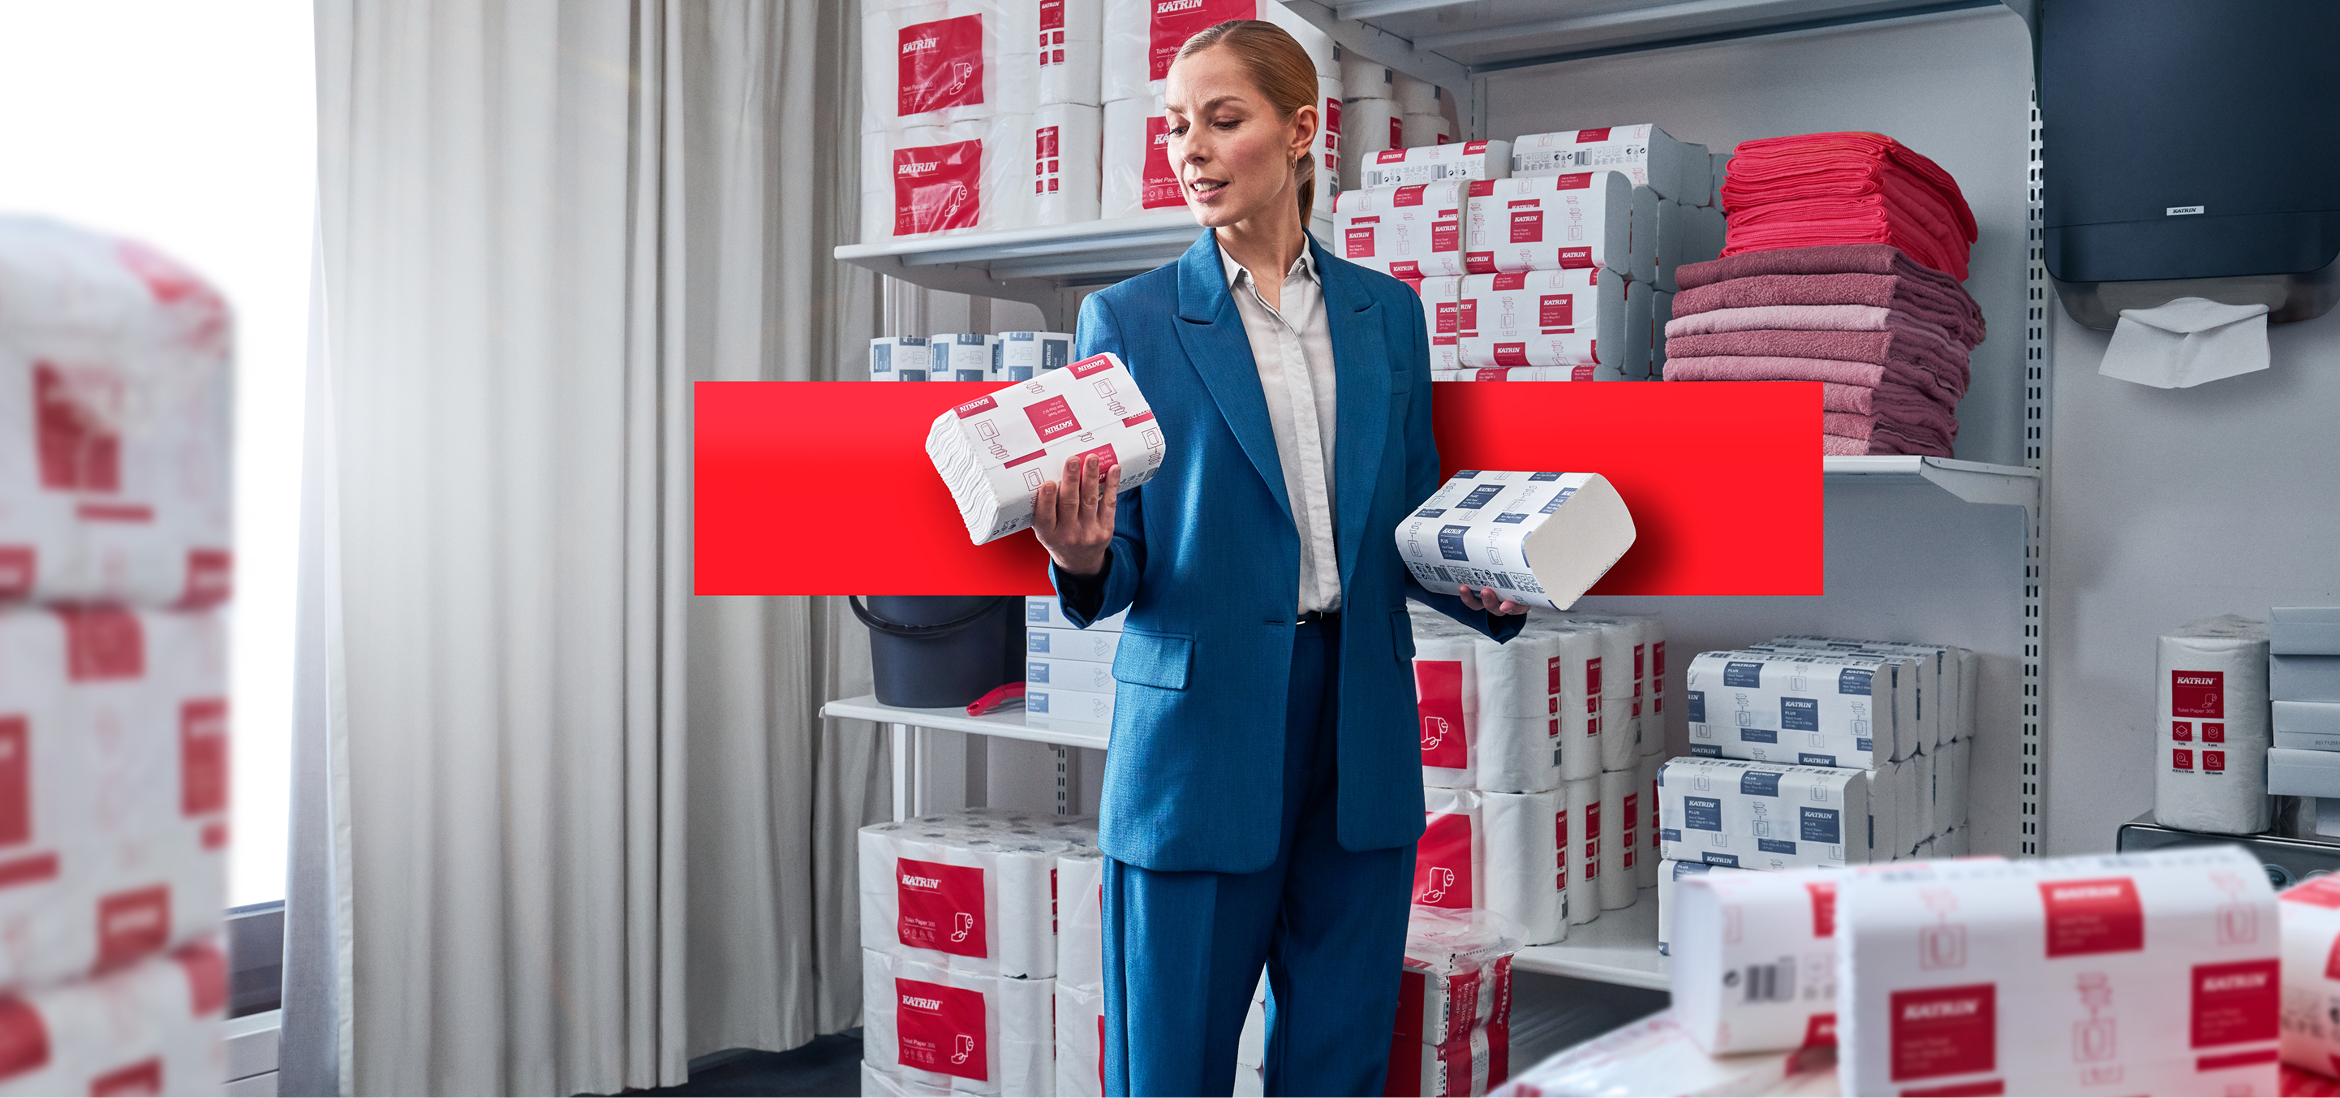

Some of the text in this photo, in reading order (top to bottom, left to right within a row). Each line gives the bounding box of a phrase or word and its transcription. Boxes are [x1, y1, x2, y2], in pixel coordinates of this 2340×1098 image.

[1157, 0, 1202, 13] KATRIN
[903, 38, 936, 53] KATRIN
[898, 162, 938, 174] KATRIN
[1078, 359, 1105, 372] KATRIN
[960, 398, 989, 413] KATRIN
[1045, 420, 1073, 435] KATRIN
[2177, 677, 2213, 685] KATRIN
[1805, 811, 1832, 819] KATRIN
[1707, 856, 1732, 864] KATRIN
[902, 875, 939, 889] KATRIN
[1497, 965, 1510, 1024] KATRIN
[903, 995, 940, 1010] KATRIN
[1903, 1000, 1979, 1020] KATRIN
[1464, 1008, 1472, 1031] Towel
